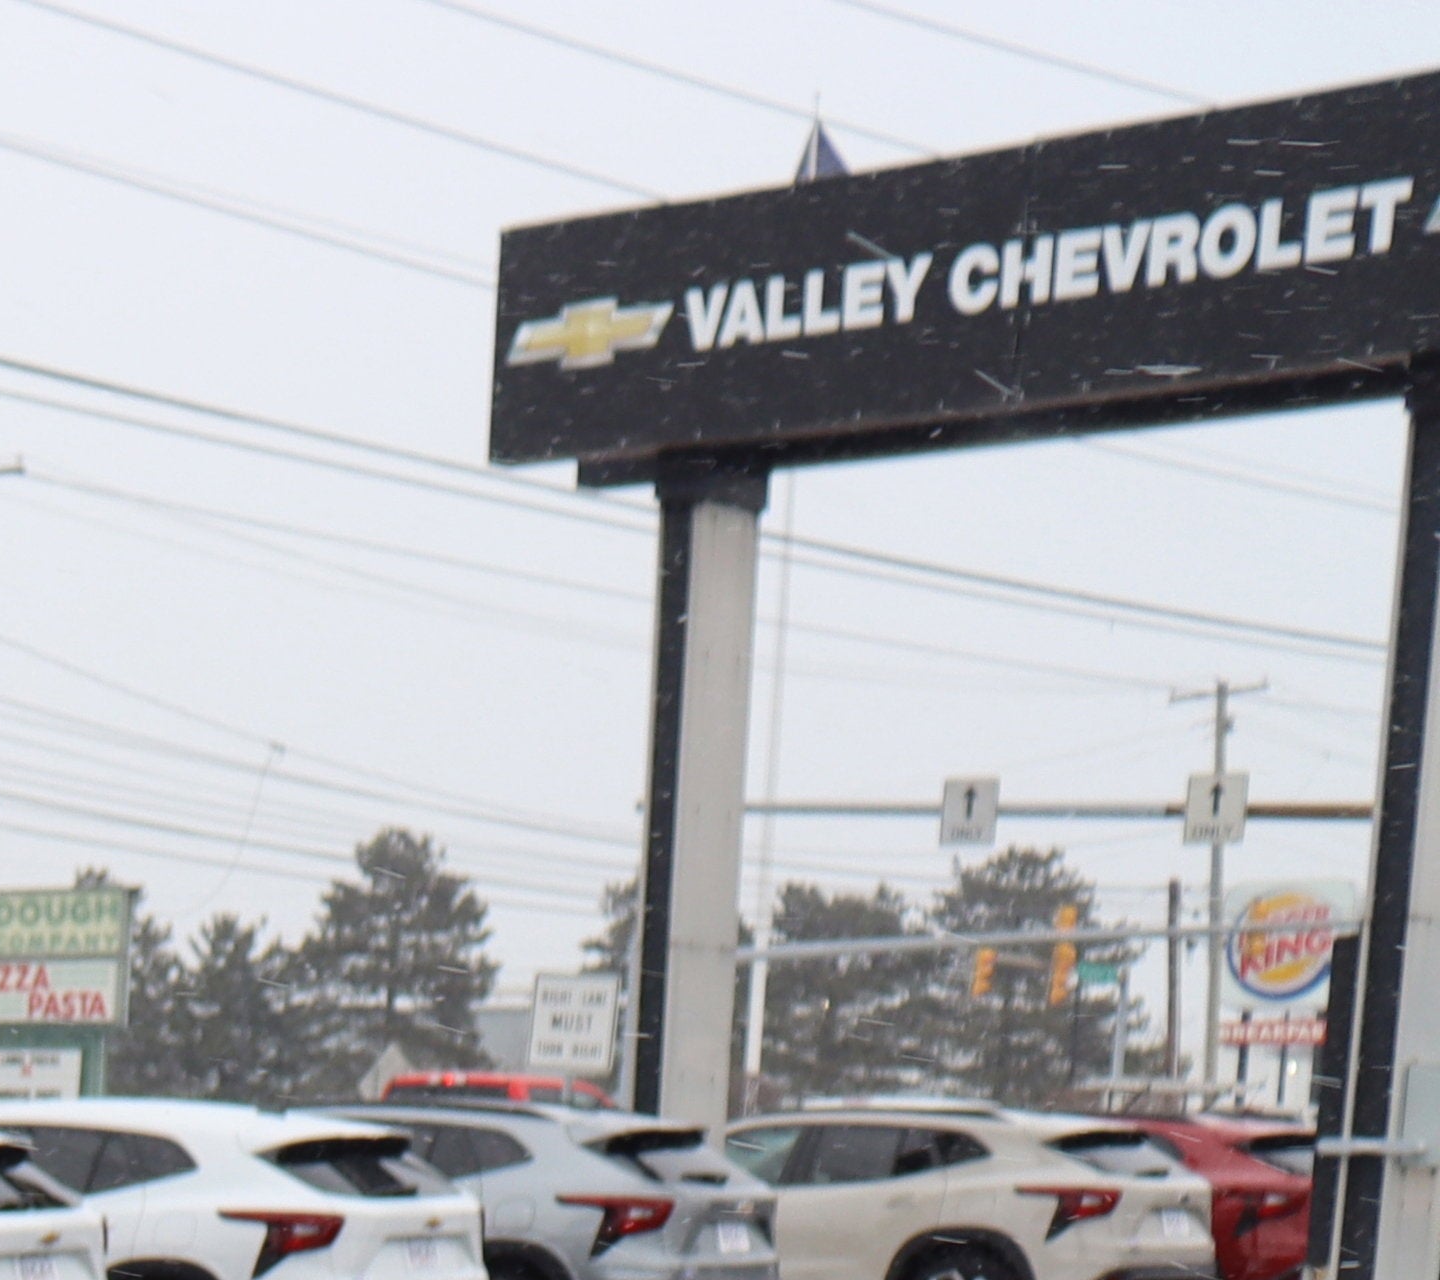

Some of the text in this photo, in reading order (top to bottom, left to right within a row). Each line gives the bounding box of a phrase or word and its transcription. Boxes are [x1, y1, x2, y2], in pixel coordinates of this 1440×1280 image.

[685, 175, 1415, 352] VALLEY CHEVROLET
[1239, 927, 1333, 980] KING
[28, 990, 107, 1019] PASTA
[551, 1012, 593, 1033] MUST
